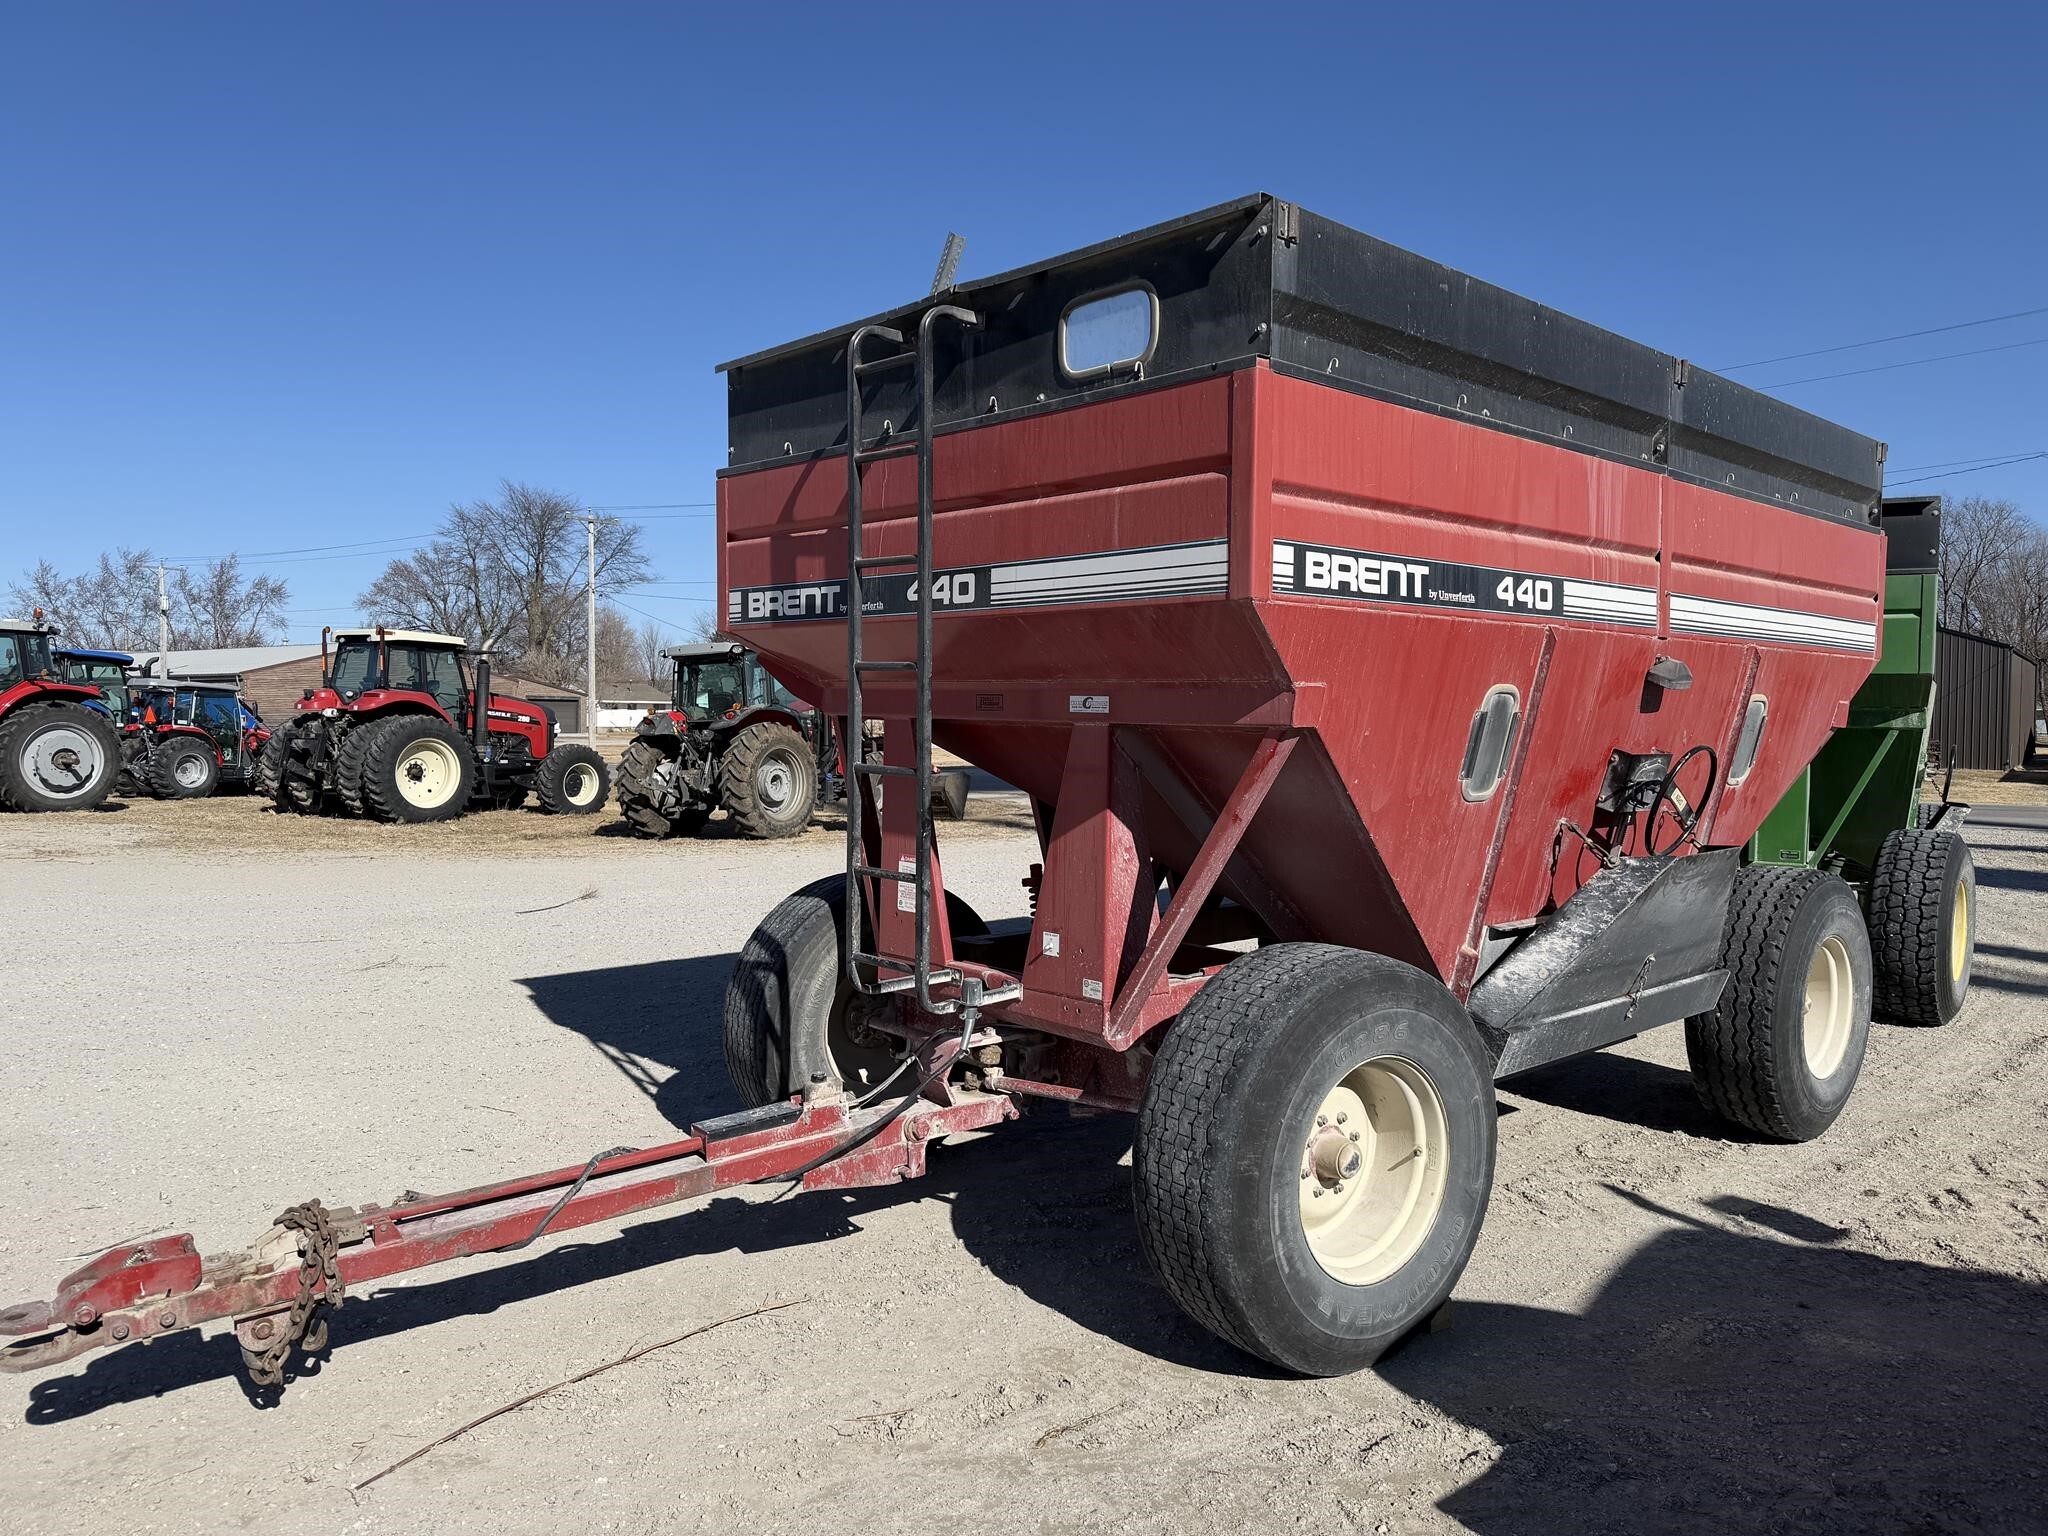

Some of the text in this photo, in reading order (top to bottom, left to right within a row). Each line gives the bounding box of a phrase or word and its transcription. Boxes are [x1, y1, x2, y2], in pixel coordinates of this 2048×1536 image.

[1305, 551, 1476, 604] BRENT by Unverferth
[1496, 576, 1553, 611] 440
[748, 585, 840, 618] BRENT
[839, 603, 848, 614] by
